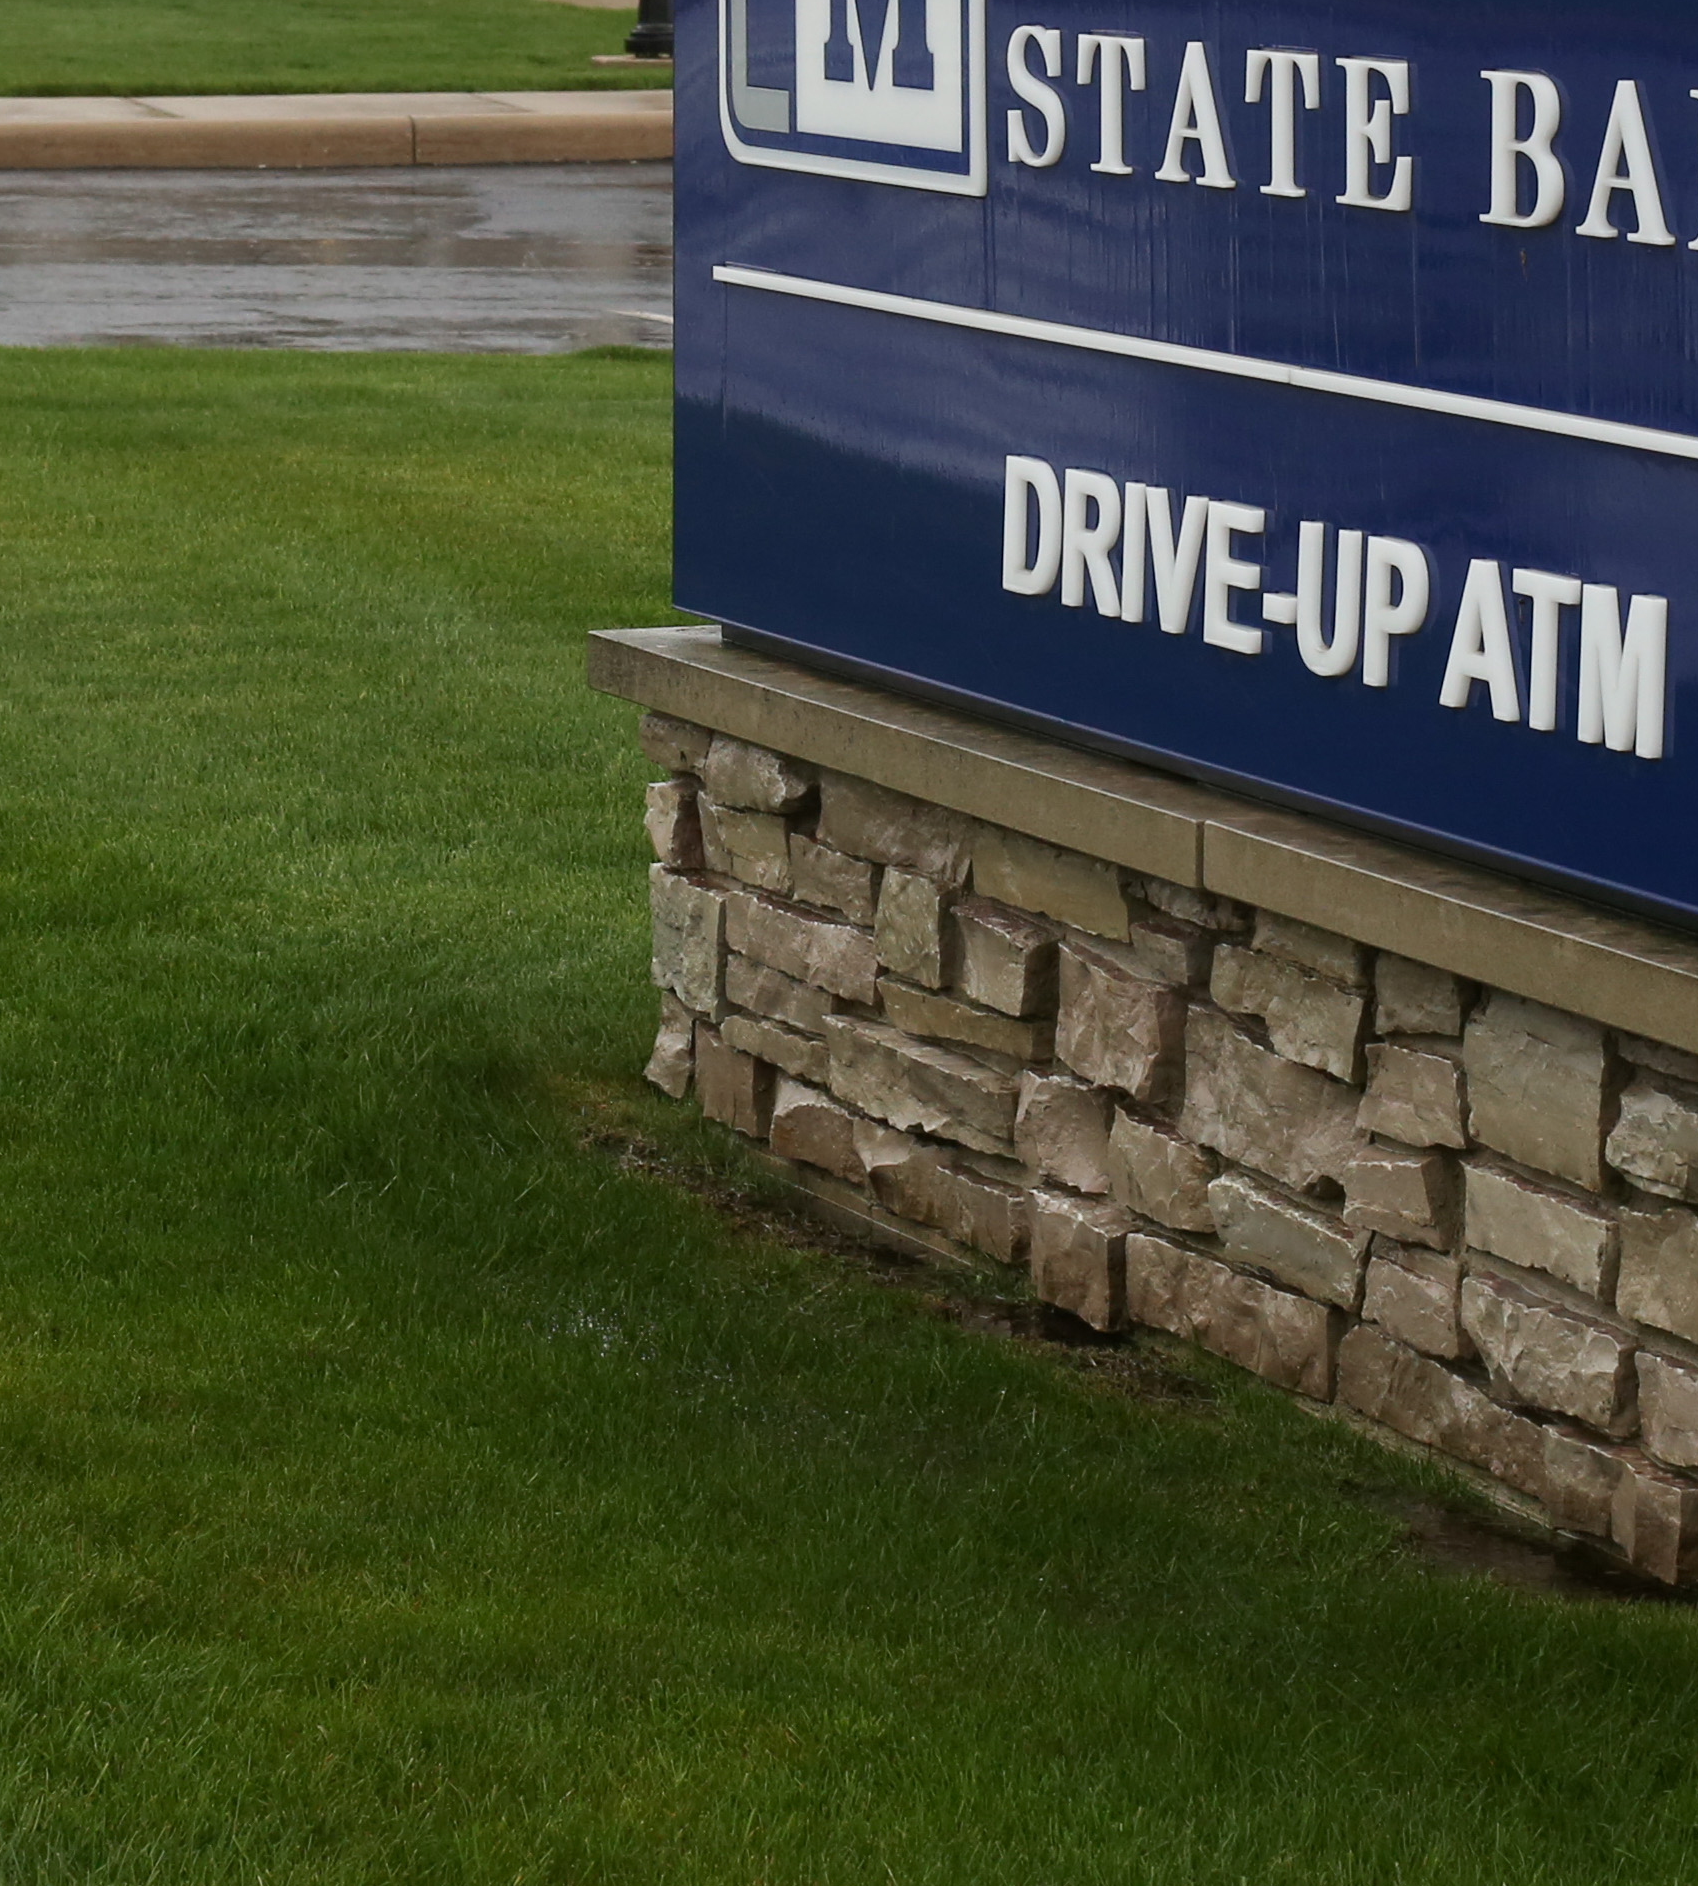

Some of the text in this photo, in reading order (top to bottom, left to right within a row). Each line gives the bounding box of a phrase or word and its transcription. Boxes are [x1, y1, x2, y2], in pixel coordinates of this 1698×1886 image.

[1007, 25, 1412, 211] STATE
[1002, 455, 1668, 759] DRIVE-UP ATM
